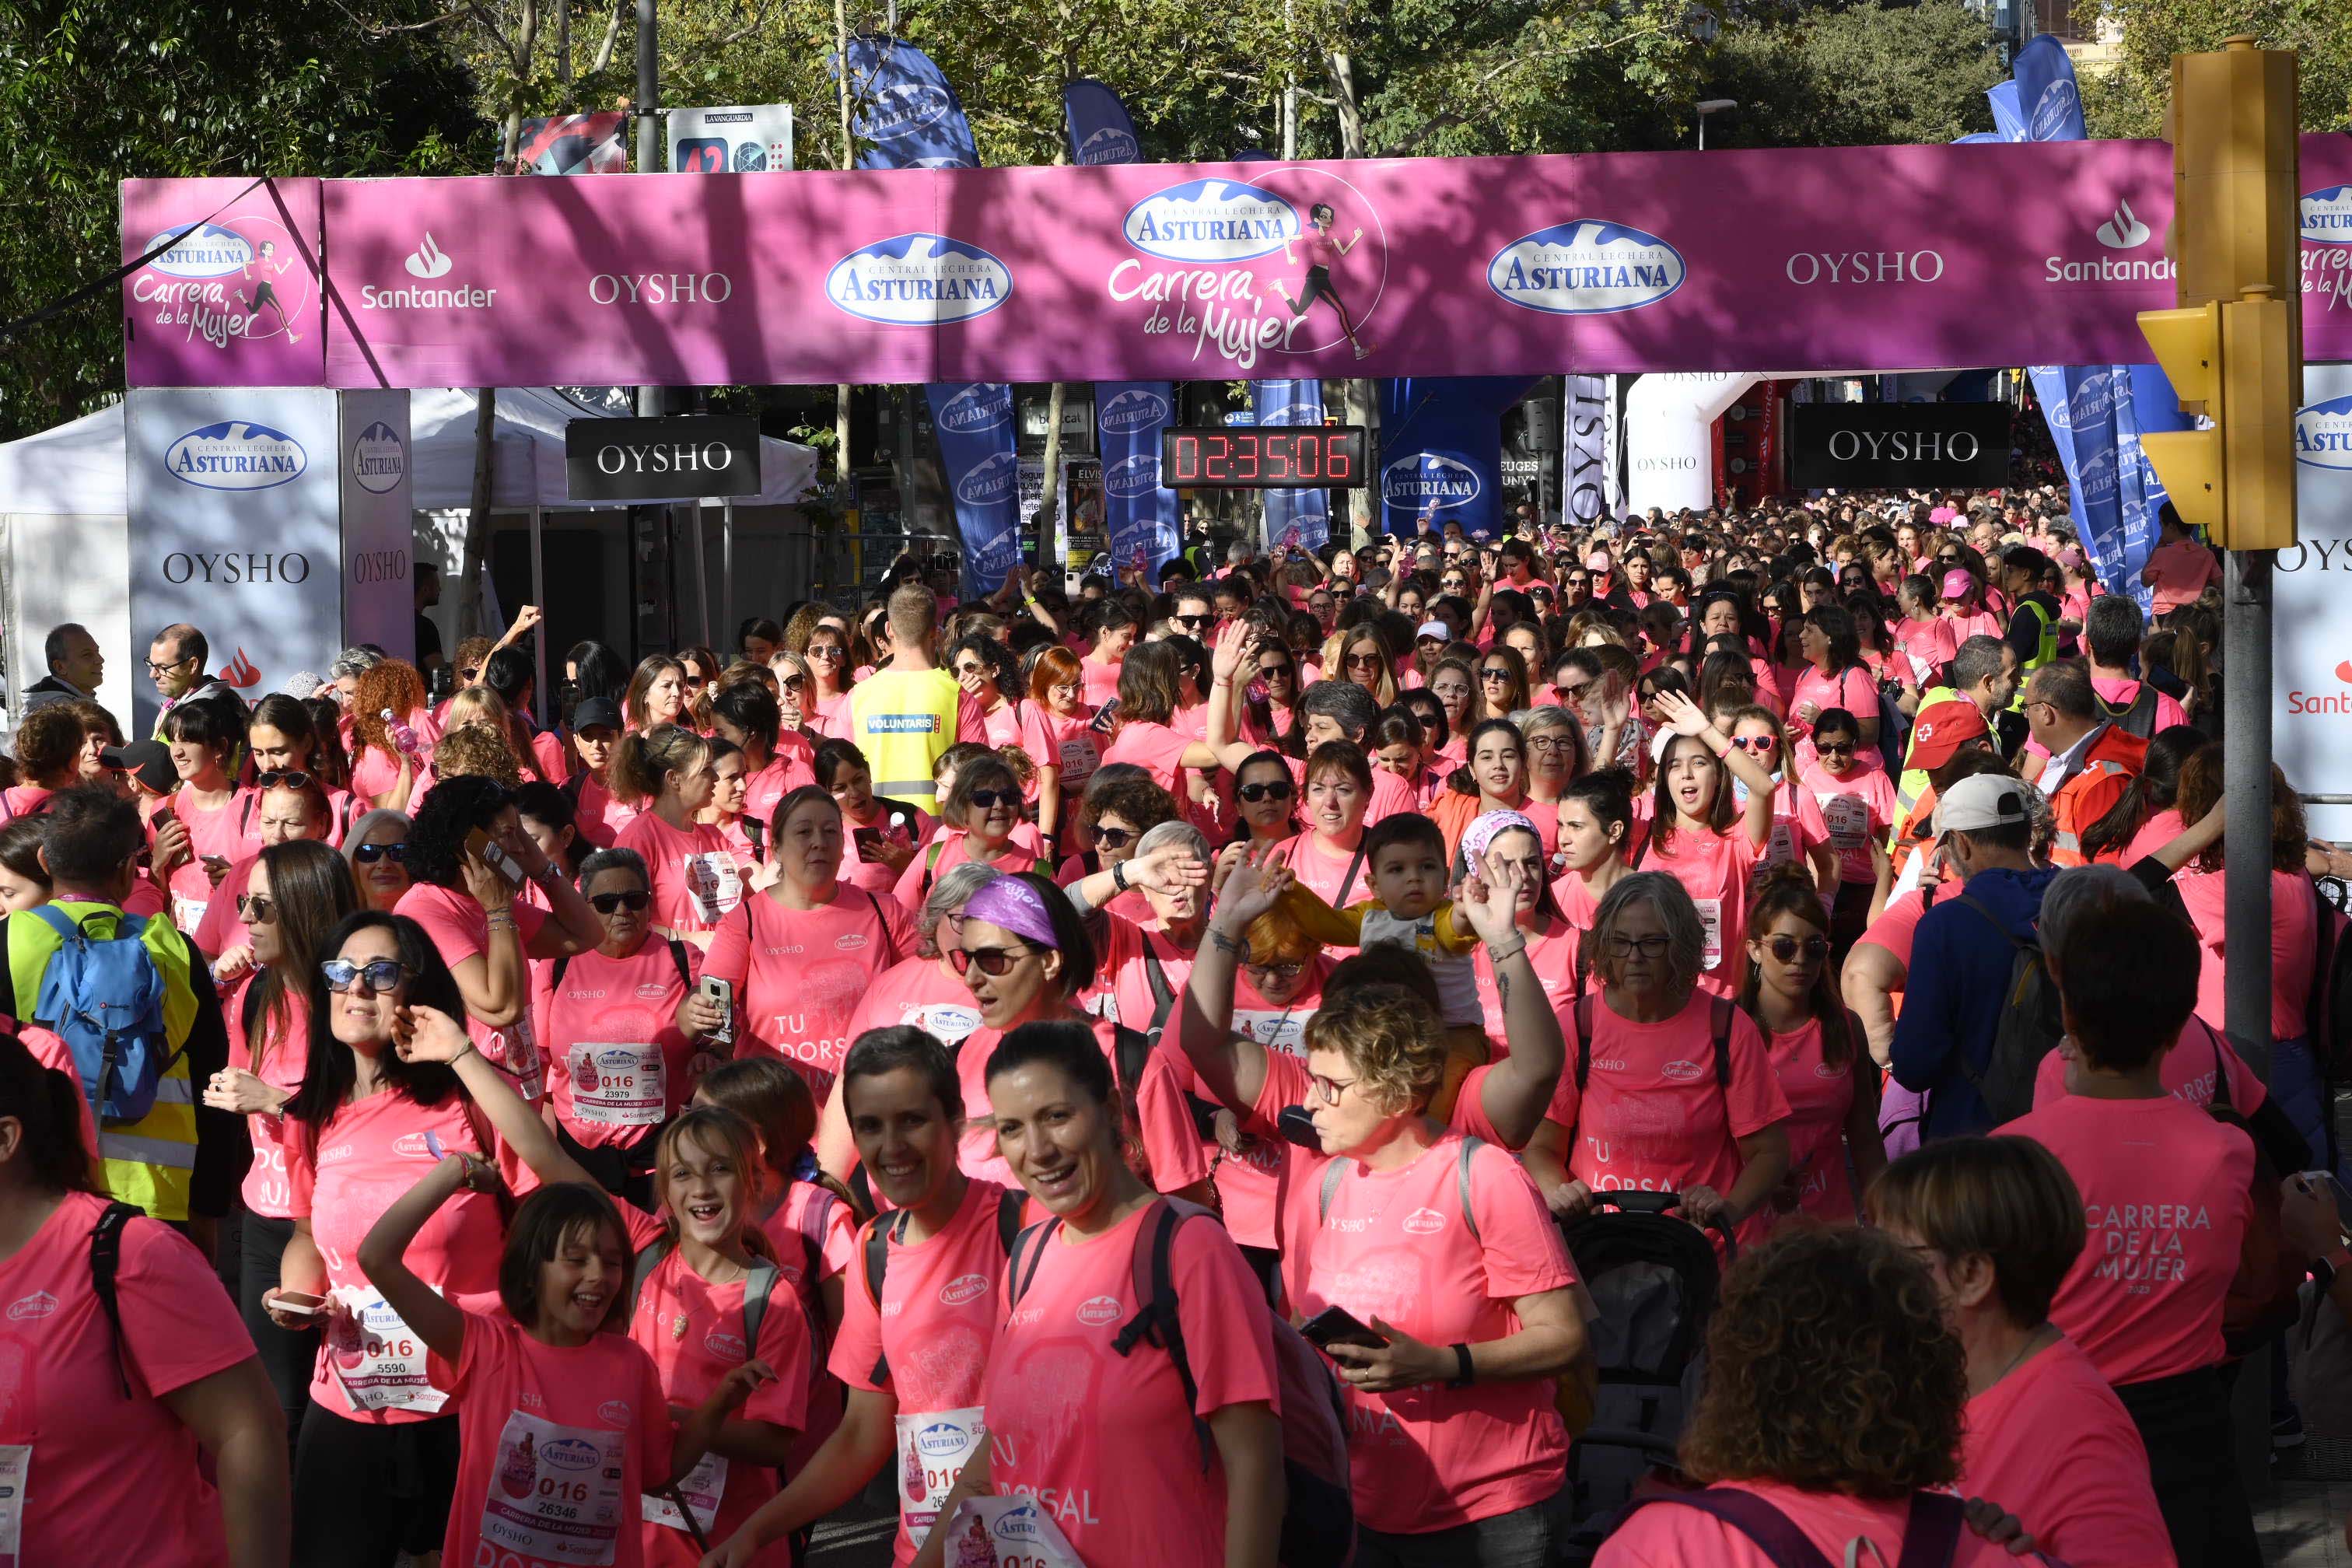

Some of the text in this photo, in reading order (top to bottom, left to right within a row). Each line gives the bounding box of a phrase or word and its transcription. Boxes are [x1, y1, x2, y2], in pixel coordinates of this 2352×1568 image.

[1164, 206, 1282, 216] CENTRAL LECHERA
[1136, 211, 1286, 241] ASTURIANA
[1533, 251, 1664, 263] CENTRAL LECHERA
[1787, 250, 1944, 285] OYSHO
[869, 264, 992, 275] CENTRAL LECHERA
[1108, 259, 1253, 302] Carrera
[1503, 257, 1671, 290] ASTURIANA
[2046, 256, 2177, 282] Santand
[133, 275, 224, 303] Carrera
[589, 273, 733, 304] OYSHO
[841, 268, 999, 301] ASTURIANA
[2318, 271, 2331, 292] la
[362, 284, 496, 309] Santander
[156, 304, 188, 324] de la
[187, 303, 259, 348] Mujer
[1143, 304, 1197, 334] de la
[1192, 296, 1309, 369] Mujer
[1829, 430, 1979, 461] OYSHO
[177, 446, 297, 473] ASTURIANA
[356, 448, 401, 476] ASTURIANA
[597, 441, 732, 474] OYSHO
[1176, 436, 1349, 479] 02:35:06
[1637, 456, 1696, 472] OYSHO
[1020, 470, 1045, 482] Segur
[1078, 469, 1102, 479] ELVIS
[1385, 476, 1473, 499] ASTURIANA
[163, 552, 310, 583] OYSHO
[354, 549, 406, 583] OYSHO
[2288, 691, 2352, 714] Sant
[868, 718, 932, 730] VOLUNTARIS
[765, 944, 803, 956] OYSHO
[568, 989, 606, 999] OYSHO
[775, 1013, 806, 1034] TU
[933, 1016, 971, 1027] ASTURIANA
[599, 1057, 636, 1066] ASTURIANA
[1591, 1059, 1626, 1070] YSHO
[601, 1076, 634, 1087] 016
[581, 1107, 607, 1118] OYSHO
[318, 1145, 352, 1164] OYSHO
[1331, 1217, 1366, 1233] YSHO
[2084, 1205, 2211, 1230] CARRERA
[2106, 1231, 2182, 1255] DE LA
[2094, 1258, 2186, 1282] MUJER
[2128, 1285, 2151, 1295] 2023
[366, 1340, 414, 1358] 016
[377, 1363, 406, 1374] 5590
[919, 1437, 966, 1450] ASTURIANA
[545, 1447, 596, 1465] ASTURIANA
[538, 1478, 587, 1502] 016
[501, 1507, 536, 1526] CARRERA
[537, 1519, 551, 1530] DE
[551, 1522, 562, 1531] LA
[565, 1524, 591, 1534] MUJER
[538, 1502, 577, 1519] 26346
[492, 1522, 533, 1546] OYSHO
